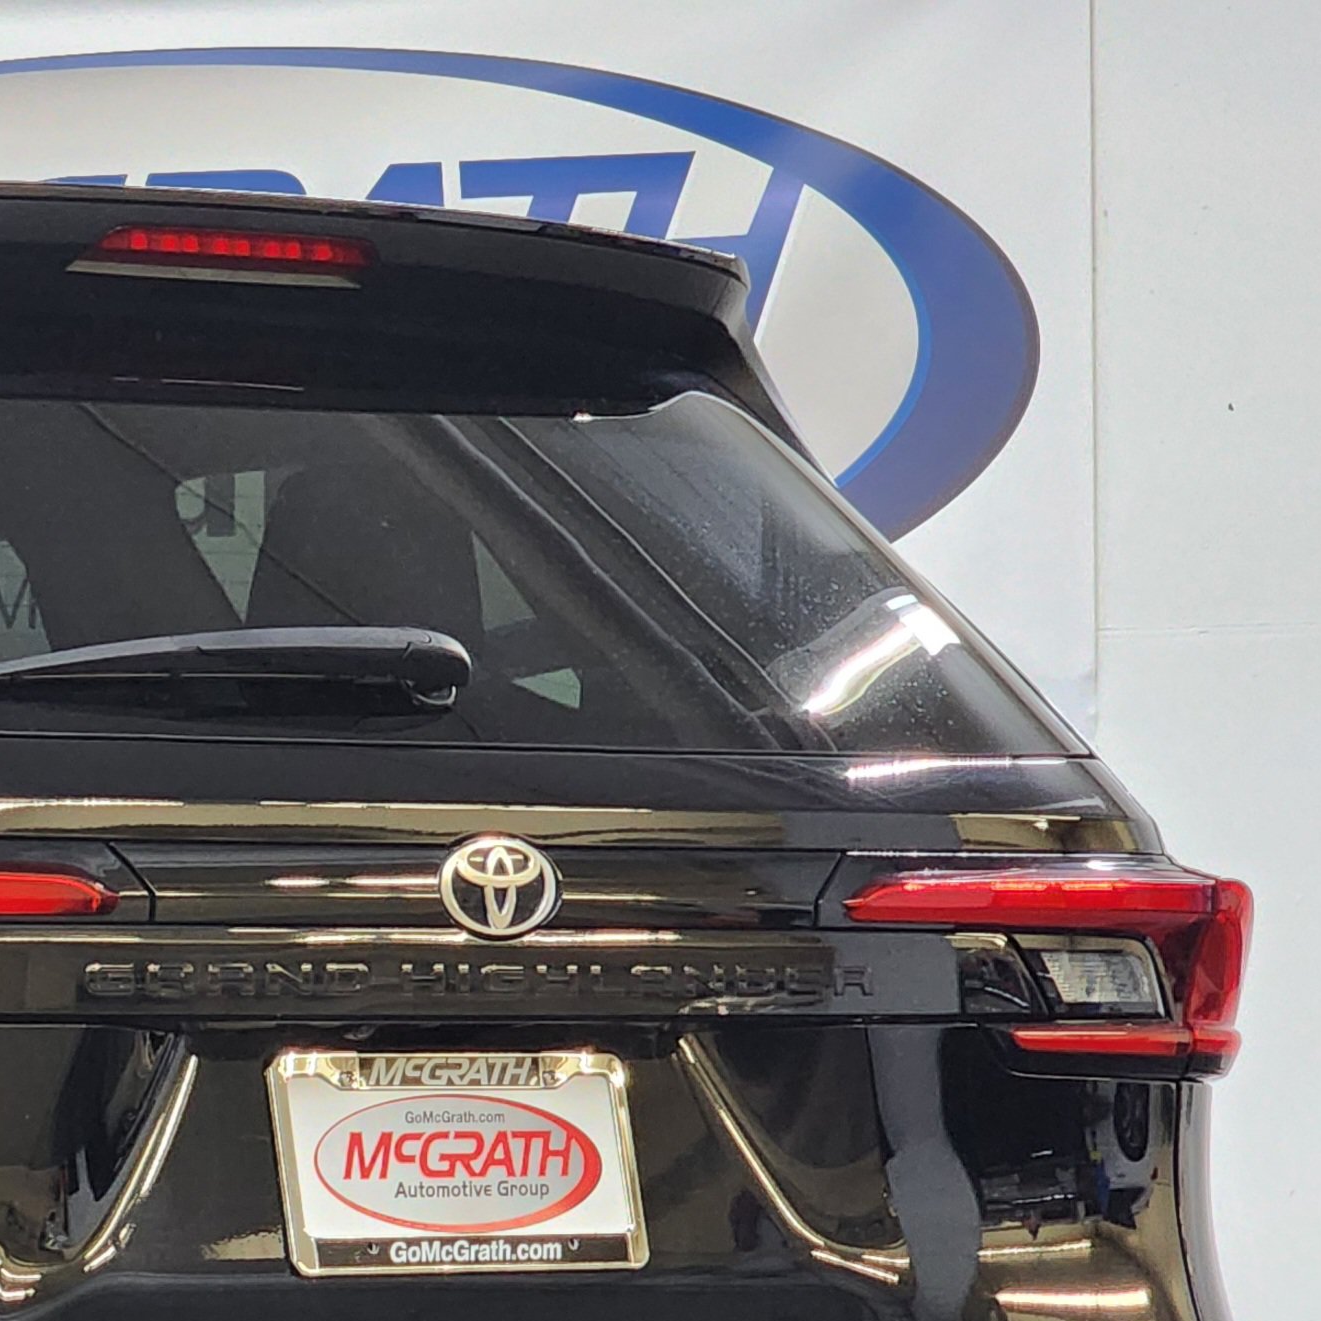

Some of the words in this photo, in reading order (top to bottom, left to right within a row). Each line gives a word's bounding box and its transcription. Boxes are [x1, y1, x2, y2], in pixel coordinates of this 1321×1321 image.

[84, 963, 370, 996] GRAND
[400, 963, 874, 998] HIGHLANDER
[404, 1110, 506, 1125] GoMcGrath.com
[394, 1181, 492, 1198] Automotive
[496, 1181, 550, 1200] Group
[389, 1239, 563, 1264] GoMcGrath.com
